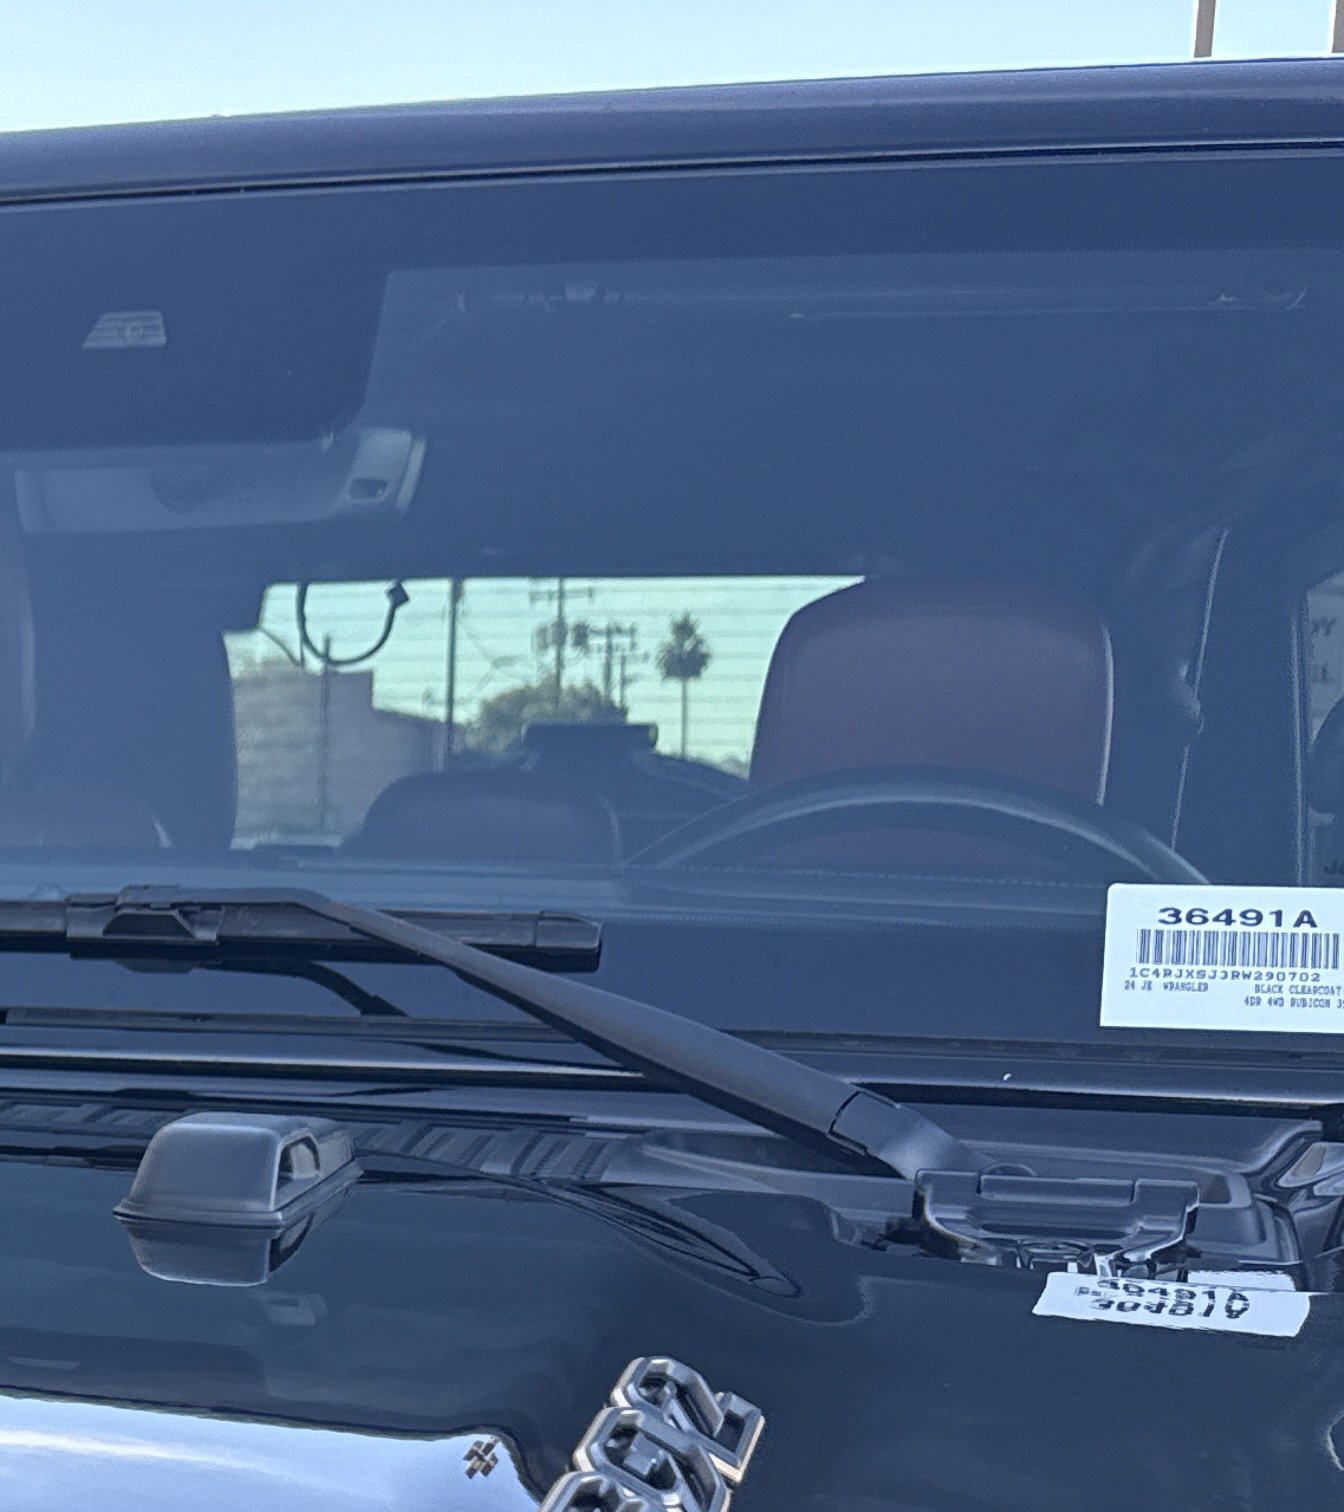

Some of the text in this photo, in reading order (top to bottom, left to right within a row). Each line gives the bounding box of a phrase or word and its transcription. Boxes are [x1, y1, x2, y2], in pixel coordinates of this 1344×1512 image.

[1157, 906, 1319, 929] 36491A
[1162, 981, 1209, 992] WRANGLER
[1253, 983, 1284, 995] BLACK
[1289, 997, 1331, 1009] RUBICON
